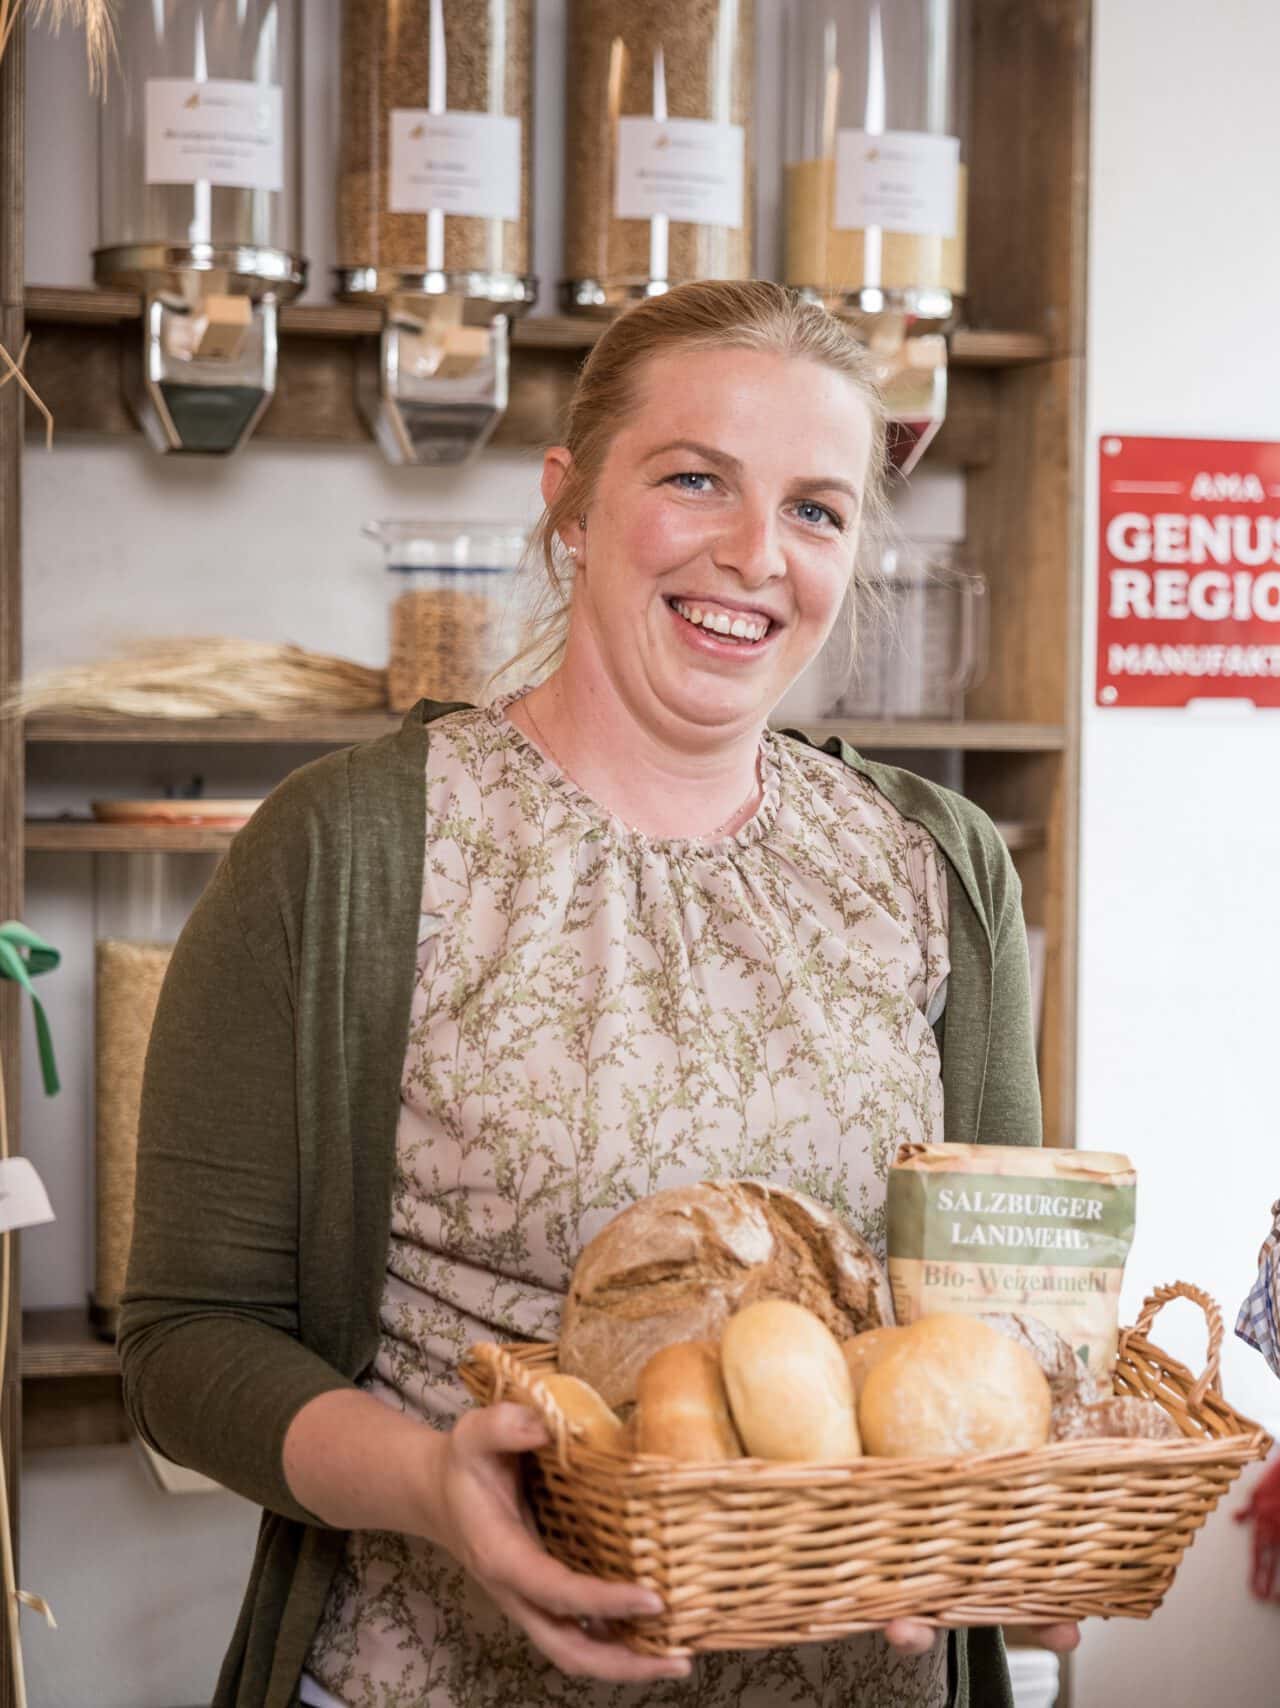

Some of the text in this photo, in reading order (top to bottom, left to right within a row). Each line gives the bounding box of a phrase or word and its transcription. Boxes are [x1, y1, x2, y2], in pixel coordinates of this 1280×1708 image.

[1190, 472, 1265, 503] AMA
[938, 1189, 1103, 1221] SALZBURGER
[951, 1222, 1090, 1249] LANDMEHL
[924, 1264, 1108, 1294] Bio-Weizenmehl
